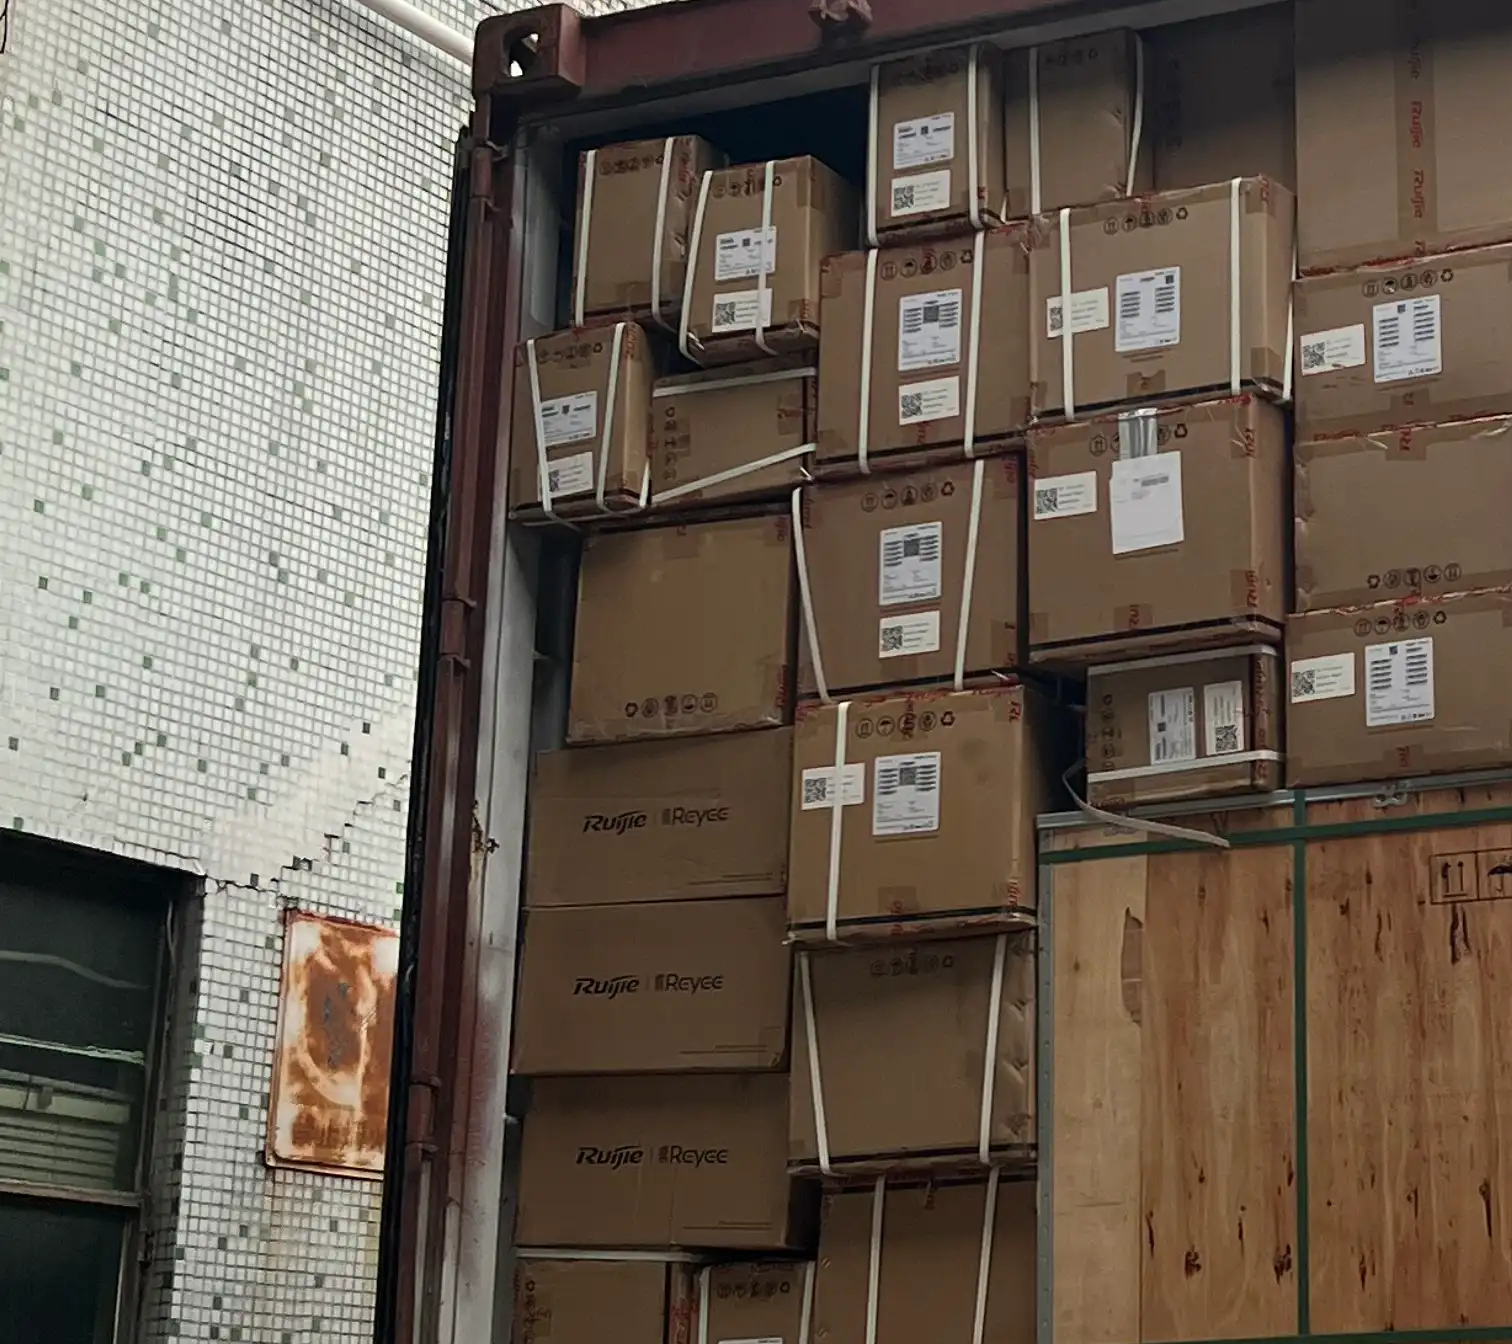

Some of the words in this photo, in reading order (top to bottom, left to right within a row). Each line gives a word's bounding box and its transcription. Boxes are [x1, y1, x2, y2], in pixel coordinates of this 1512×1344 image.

[1409, 100, 1423, 149] Ruijie
[1412, 169, 1425, 219] Ruijie
[583, 809, 647, 836] Ruijie
[672, 806, 730, 827] Reyee
[573, 974, 640, 1000] Ruijie
[665, 973, 724, 995] Reyee
[576, 1145, 644, 1170] Ruijie
[670, 1145, 729, 1168] Reyee
